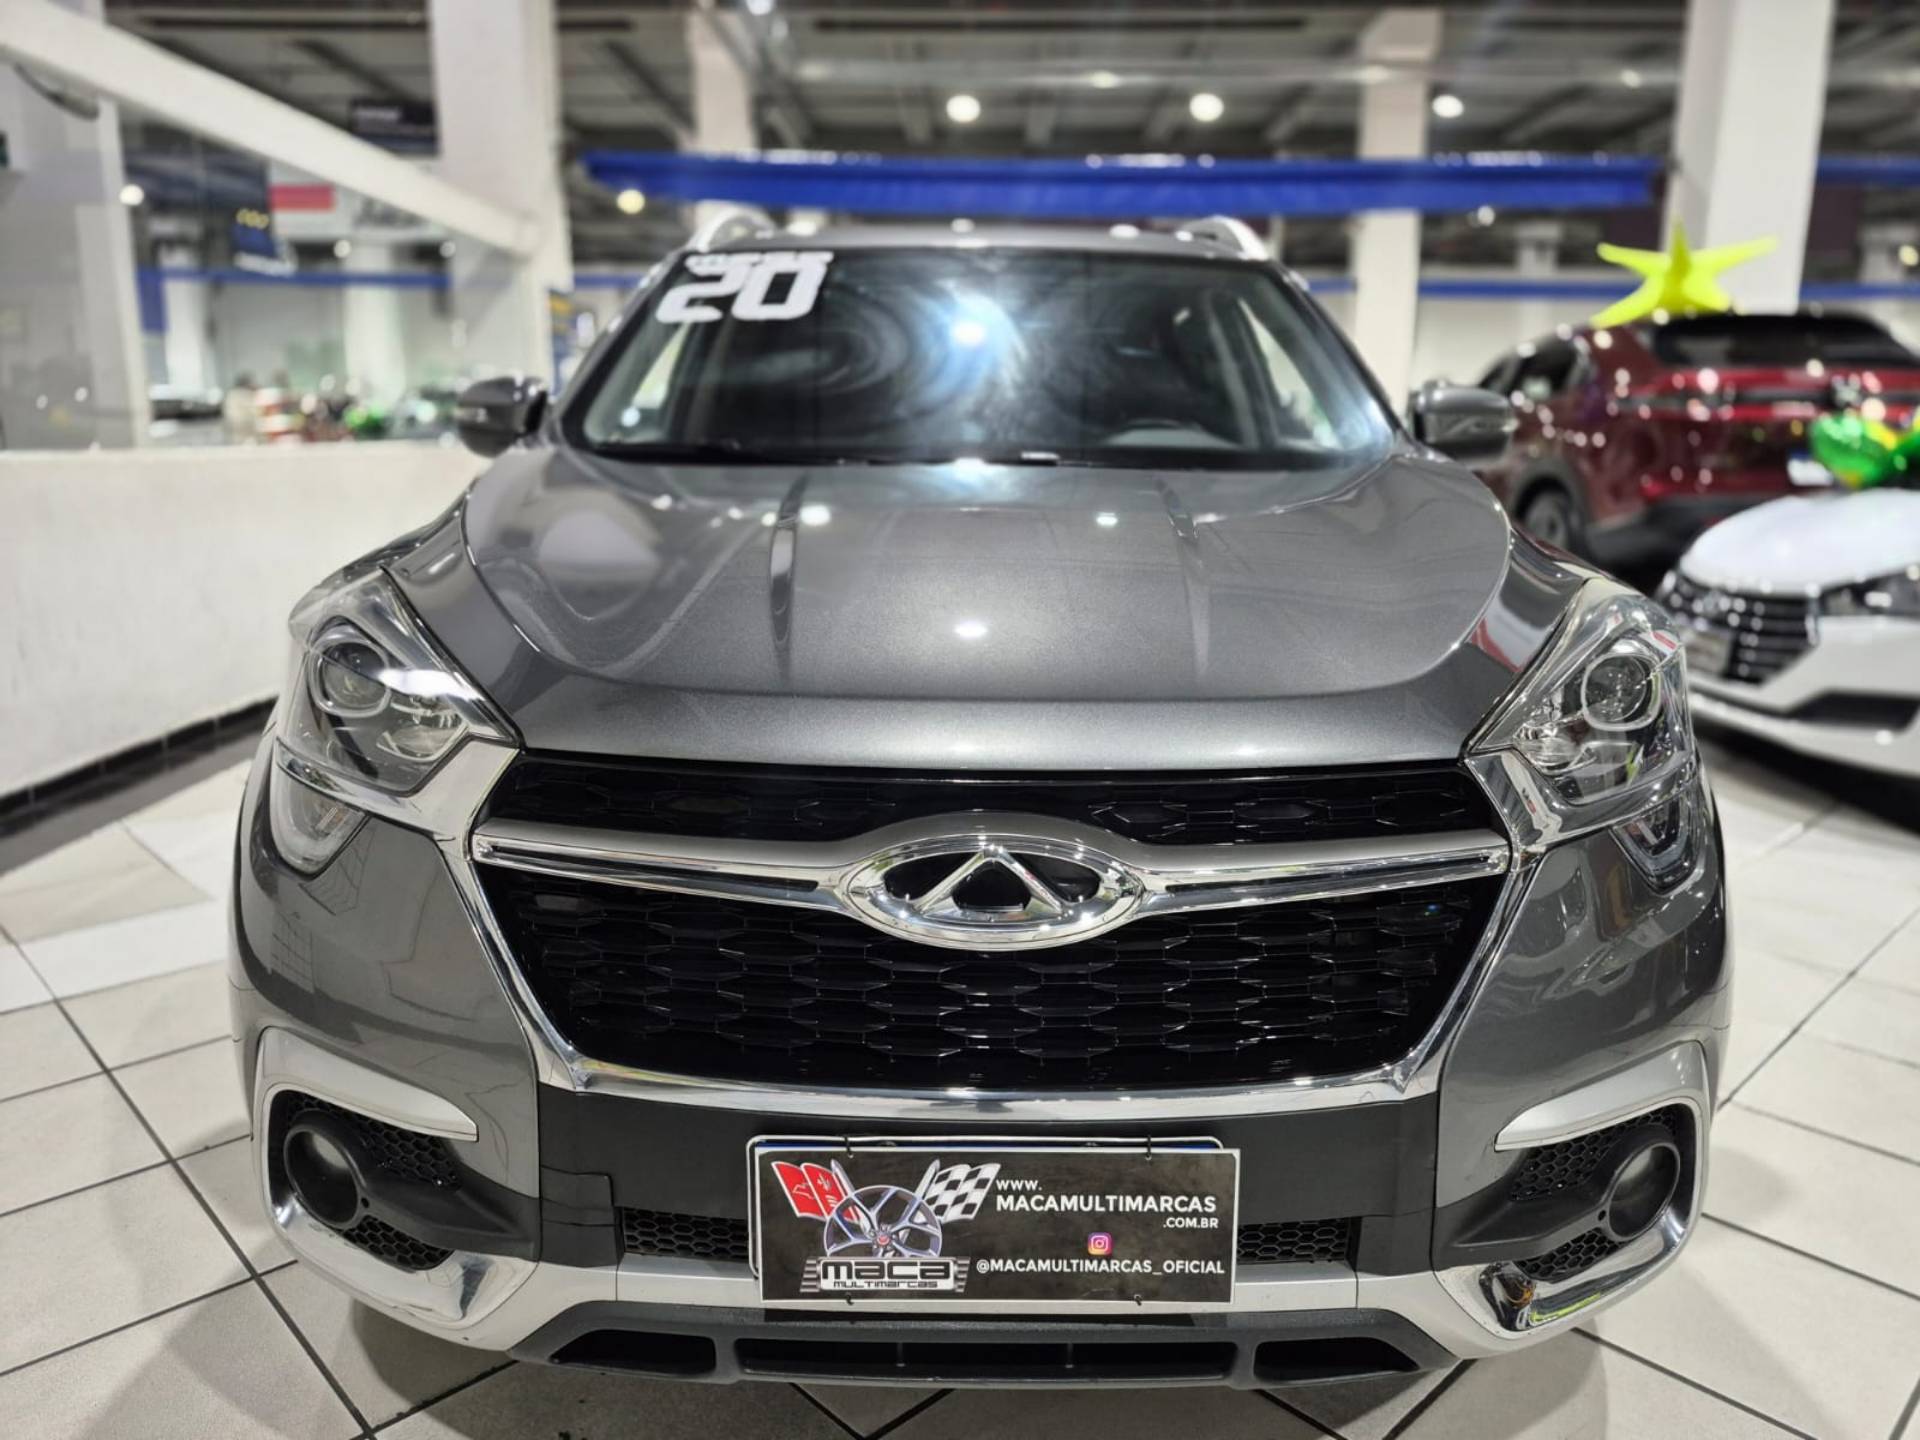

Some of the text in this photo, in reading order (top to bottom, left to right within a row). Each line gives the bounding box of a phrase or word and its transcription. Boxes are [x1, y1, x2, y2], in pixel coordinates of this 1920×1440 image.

[655, 253, 831, 323] 20
[996, 1194, 1217, 1213] MACAMULTIMARCAS
[1163, 1217, 1219, 1229] .COM.BR
[976, 1258, 1225, 1275] @MACAMULTIMARCAS_OFICIAL
